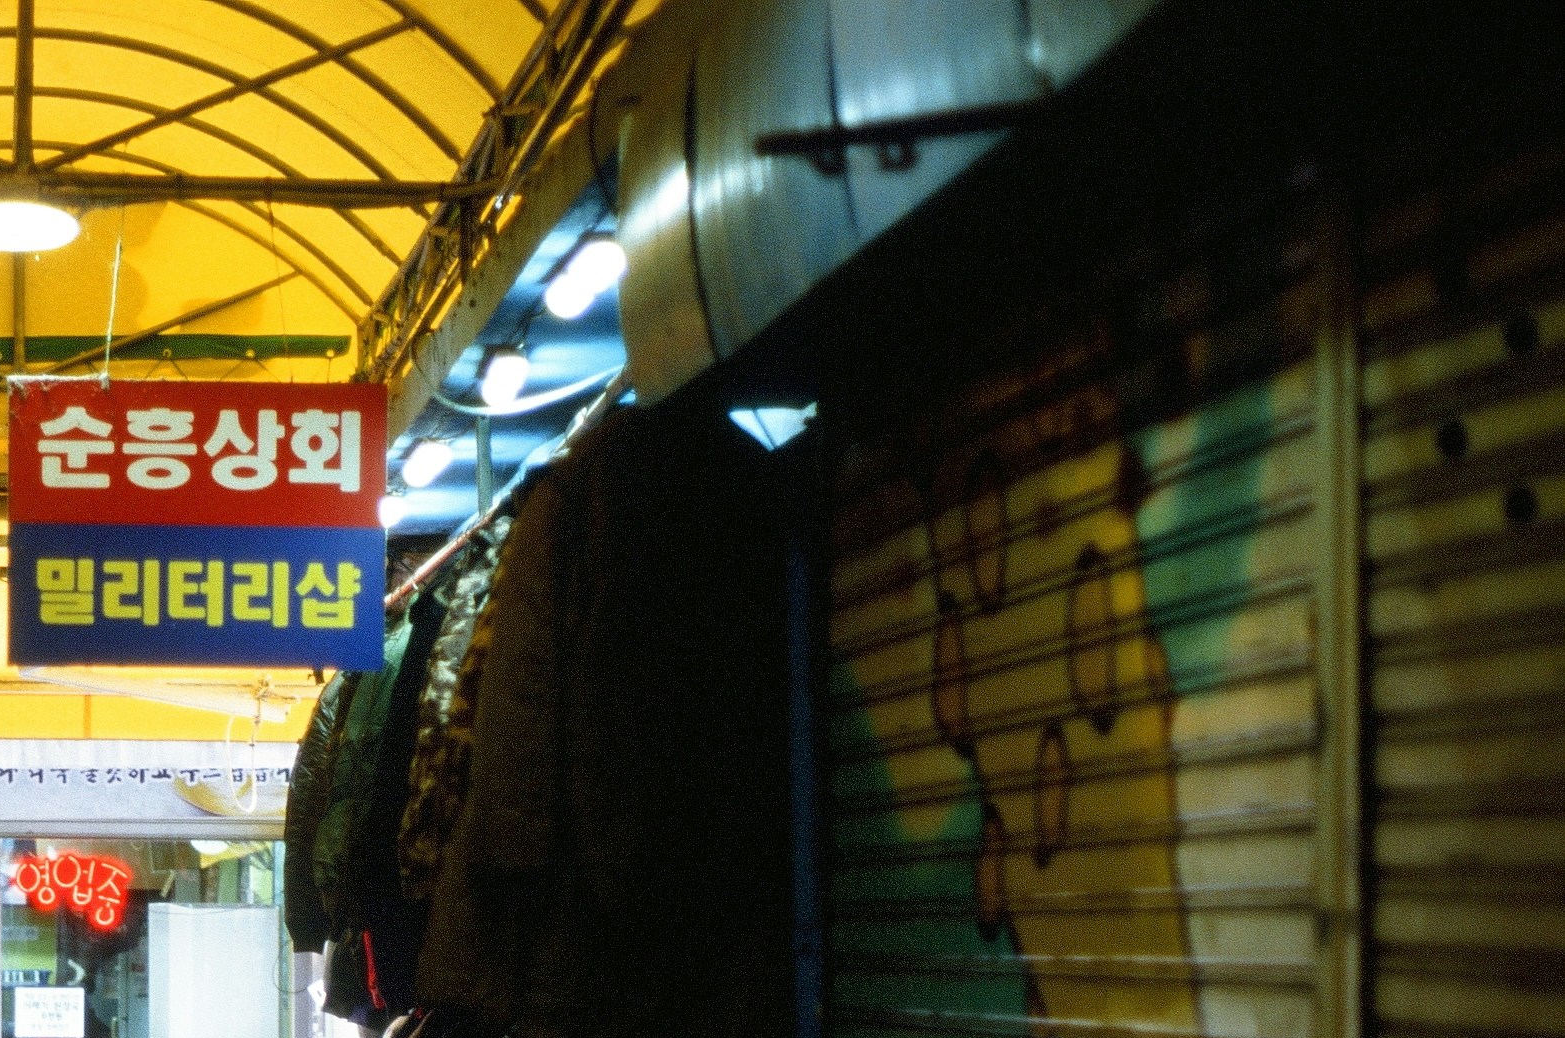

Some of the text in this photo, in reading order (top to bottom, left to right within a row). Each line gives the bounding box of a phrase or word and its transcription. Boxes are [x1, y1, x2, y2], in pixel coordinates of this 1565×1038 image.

[37, 405, 362, 493] 순흥상회
[36, 557, 362, 629] 밀리터리샵
[15, 854, 129, 926] 영업중
